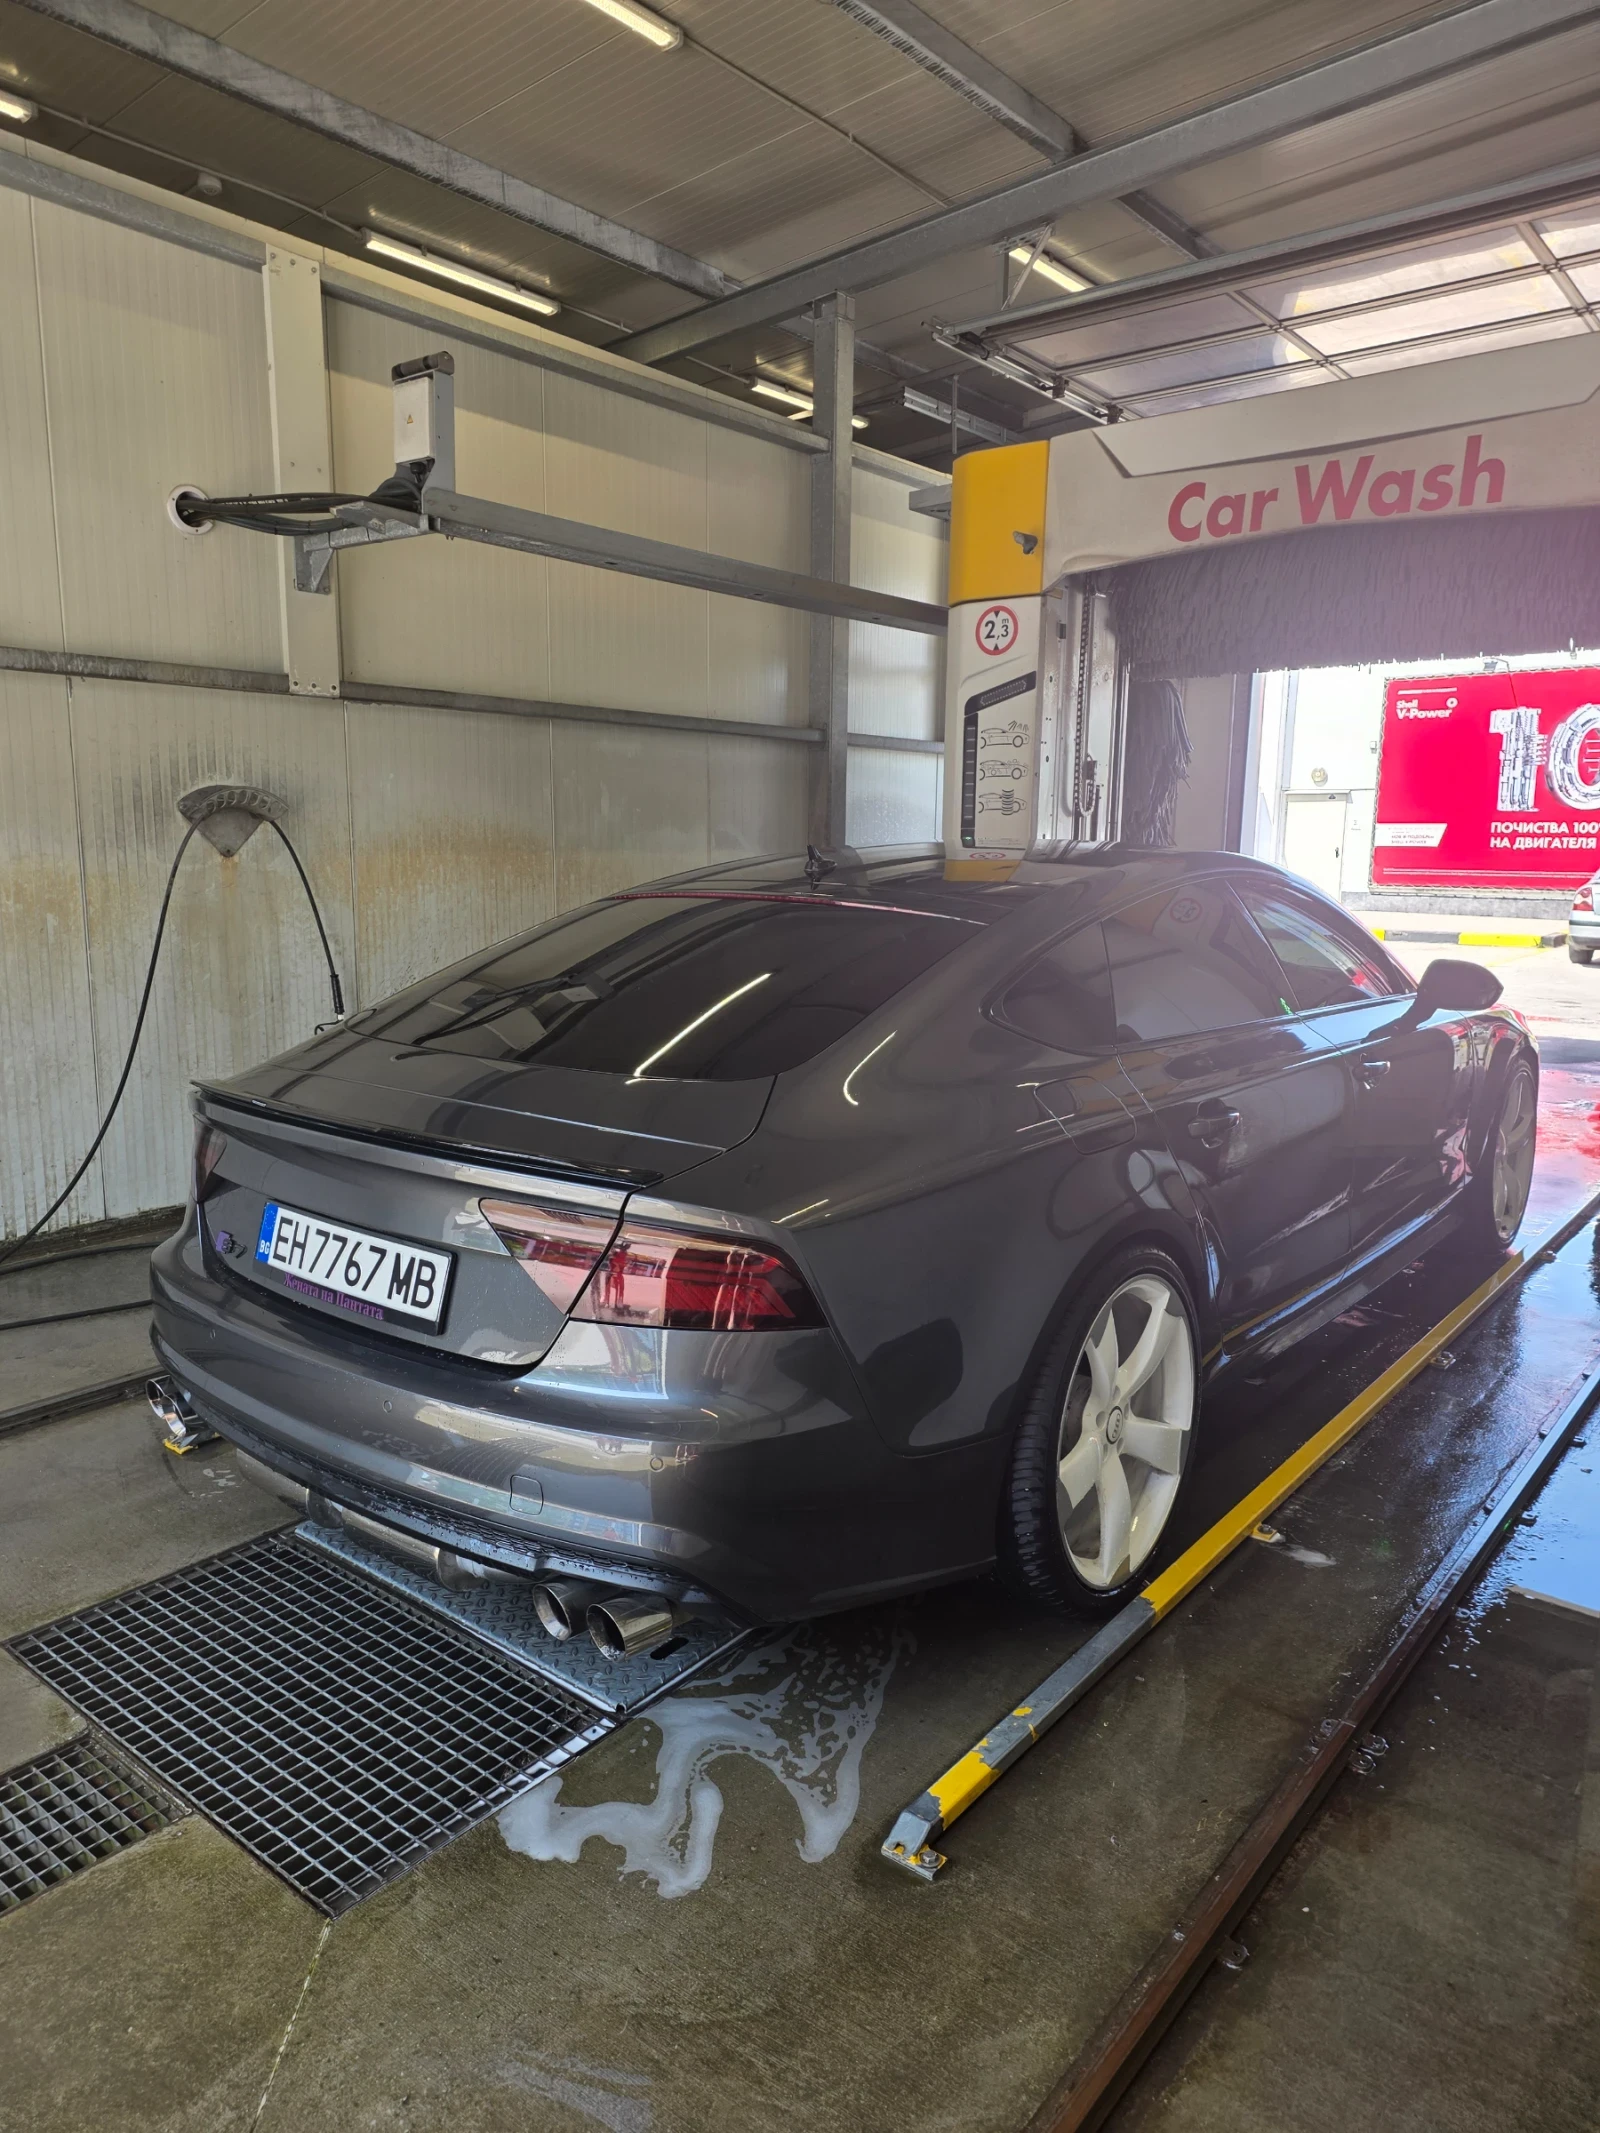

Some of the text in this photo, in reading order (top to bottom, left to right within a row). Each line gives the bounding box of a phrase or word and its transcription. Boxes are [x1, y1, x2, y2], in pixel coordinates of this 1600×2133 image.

[1168, 434, 1505, 542] Car Wash
[984, 620, 1009, 640] 2,3
[1396, 699, 1418, 708] Shell
[1396, 708, 1452, 719] V-Power
[1491, 822, 1600, 834] ПОЧИСТВА 100
[1490, 837, 1597, 850] НА ДВИГАТЕЛЯ
[259, 1240, 271, 1255] BG
[283, 1272, 385, 1320] Жената на Пантата
